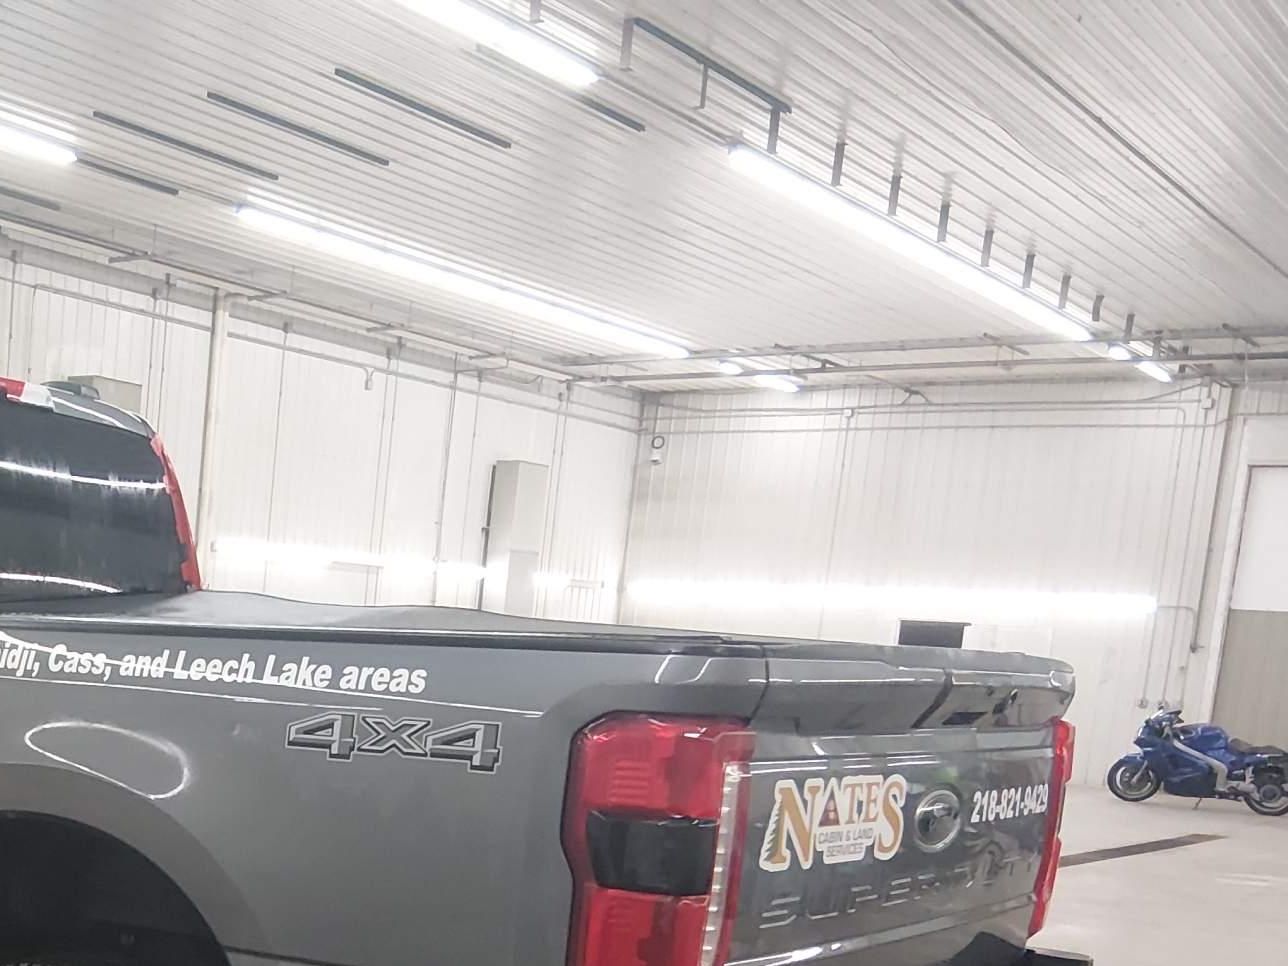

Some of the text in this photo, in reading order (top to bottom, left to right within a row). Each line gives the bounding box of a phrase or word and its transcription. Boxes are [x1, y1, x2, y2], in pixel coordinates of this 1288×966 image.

[48, 643, 112, 682] Cass,
[119, 649, 167, 678] and
[173, 650, 255, 684] Leech
[263, 654, 332, 688] Lake
[339, 665, 427, 694] areas
[970, 784, 1049, 823] 218-821-9429
